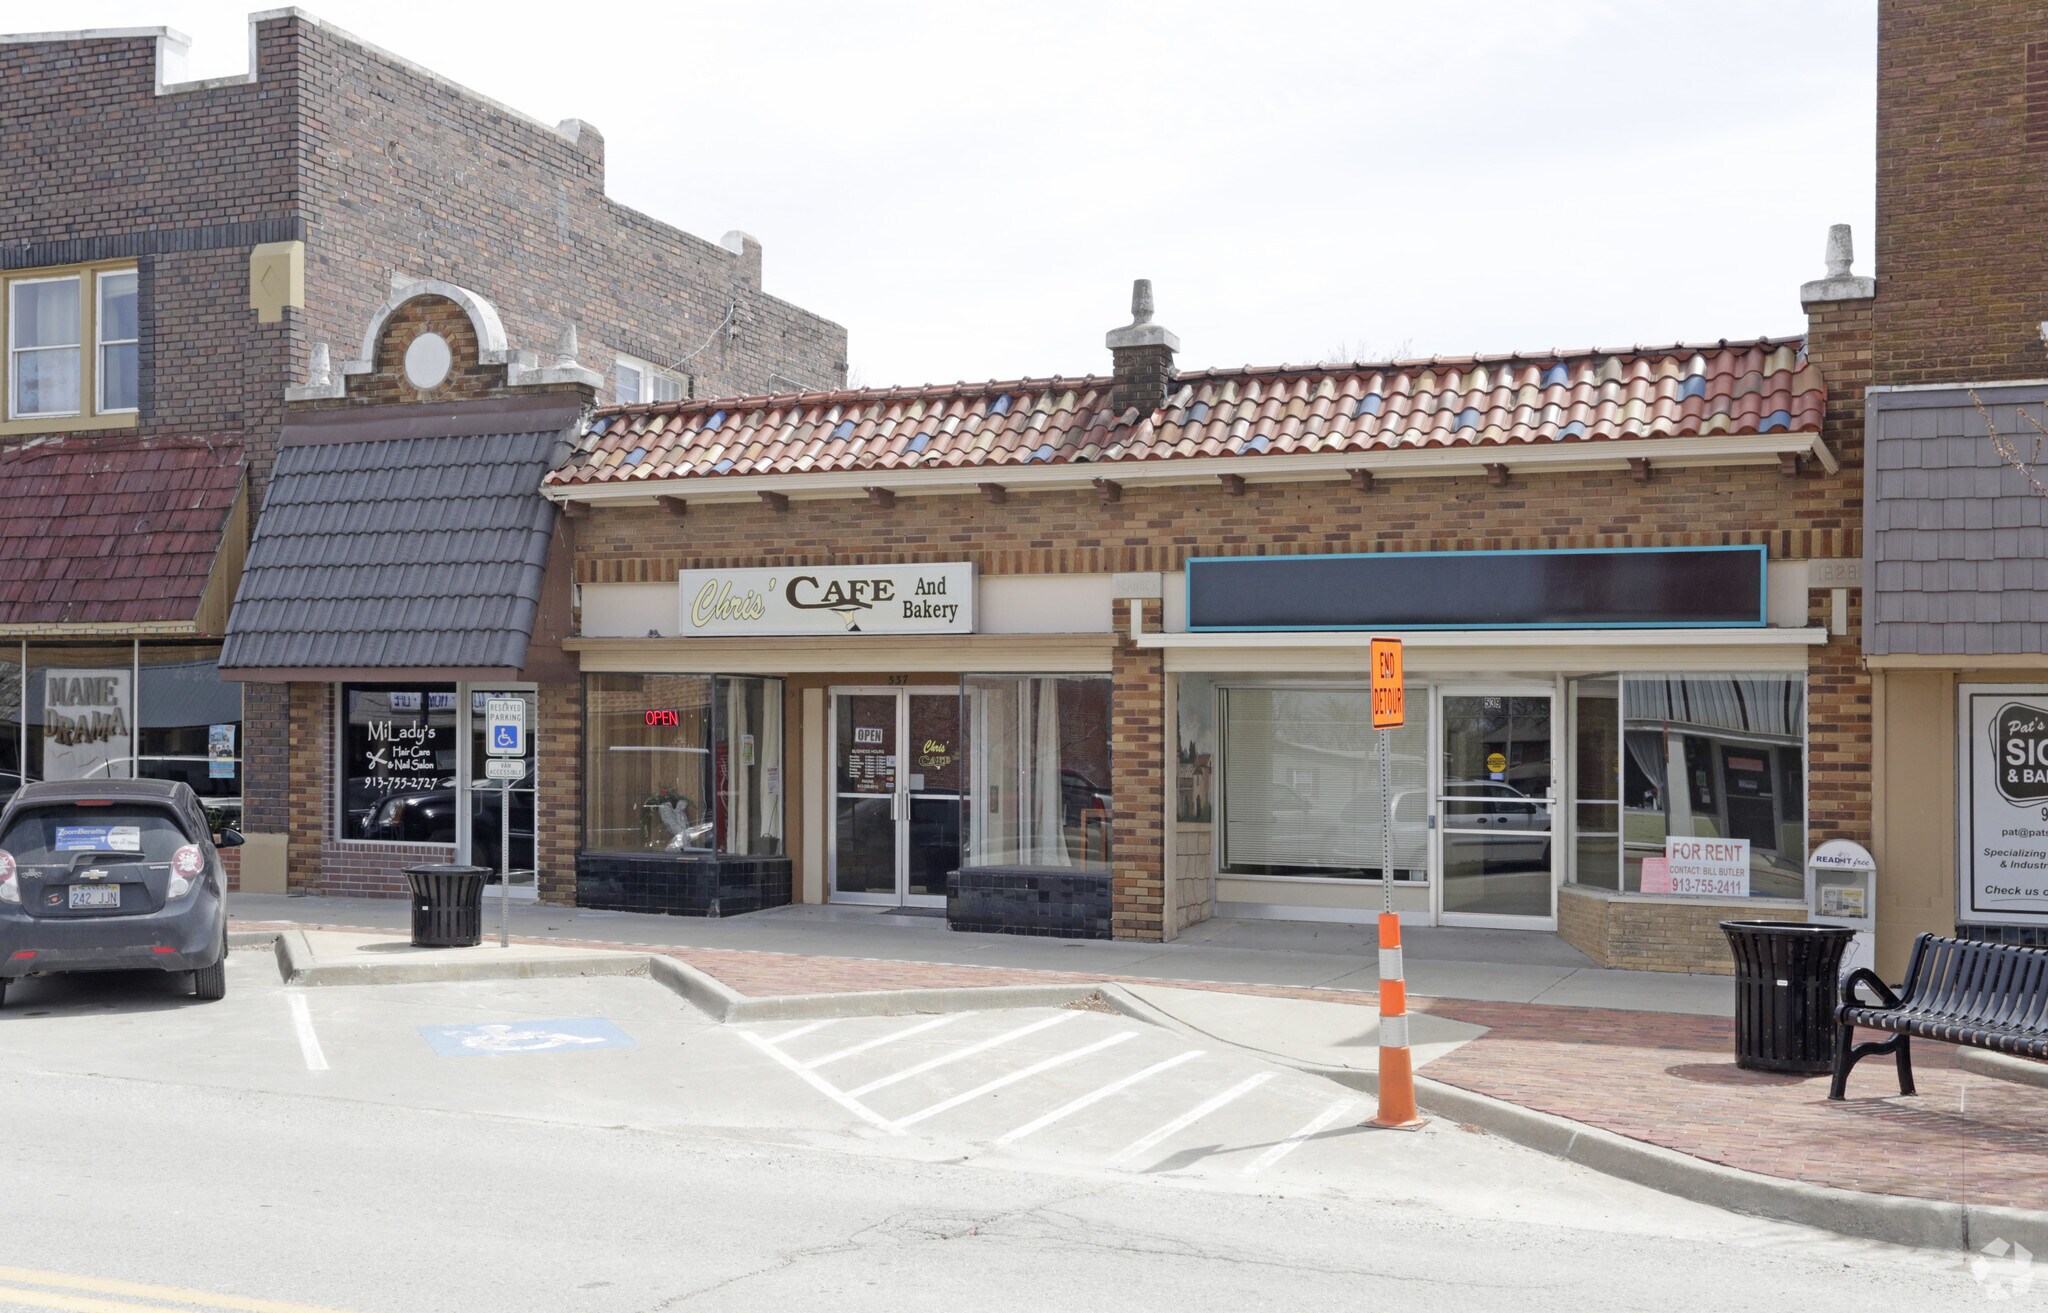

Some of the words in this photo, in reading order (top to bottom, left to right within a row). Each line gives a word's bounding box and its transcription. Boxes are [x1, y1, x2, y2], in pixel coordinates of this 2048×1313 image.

[914, 576, 947, 596] And
[691, 577, 777, 628] Chris'
[785, 575, 896, 610] CAFE
[902, 600, 959, 623] Bakery
[1380, 652, 1395, 679] END
[888, 674, 909, 685] 537
[48, 677, 119, 706] MANE
[490, 703, 522, 712] RESERVED
[1374, 688, 1402, 714] DETOUR
[490, 713, 522, 721] PARKING
[645, 710, 679, 726] OPEN
[44, 707, 128, 747] DRAMA
[367, 720, 436, 745] MiLady's
[2007, 716, 2046, 736] Pat's
[858, 728, 882, 742] OPEN
[392, 745, 411, 758] Hair
[410, 745, 431, 758] Care
[394, 758, 410, 770] Nail
[410, 758, 435, 770] Salon
[2007, 768, 2019, 783] &
[364, 776, 438, 790] 913-755-2727
[57, 828, 107, 837] ZoomBenefits
[1672, 843, 1701, 860] FOR
[1705, 844, 1743, 862] RENT
[1983, 848, 2047, 860] Specializing
[2000, 860, 2007, 869] &
[1702, 867, 1717, 876] BILL
[1718, 868, 1745, 877] BUTLER
[1671, 878, 1741, 894] 913-755-2411
[1984, 885, 2021, 896] Check
[2025, 888, 2040, 896] us
[72, 892, 92, 905] 242
